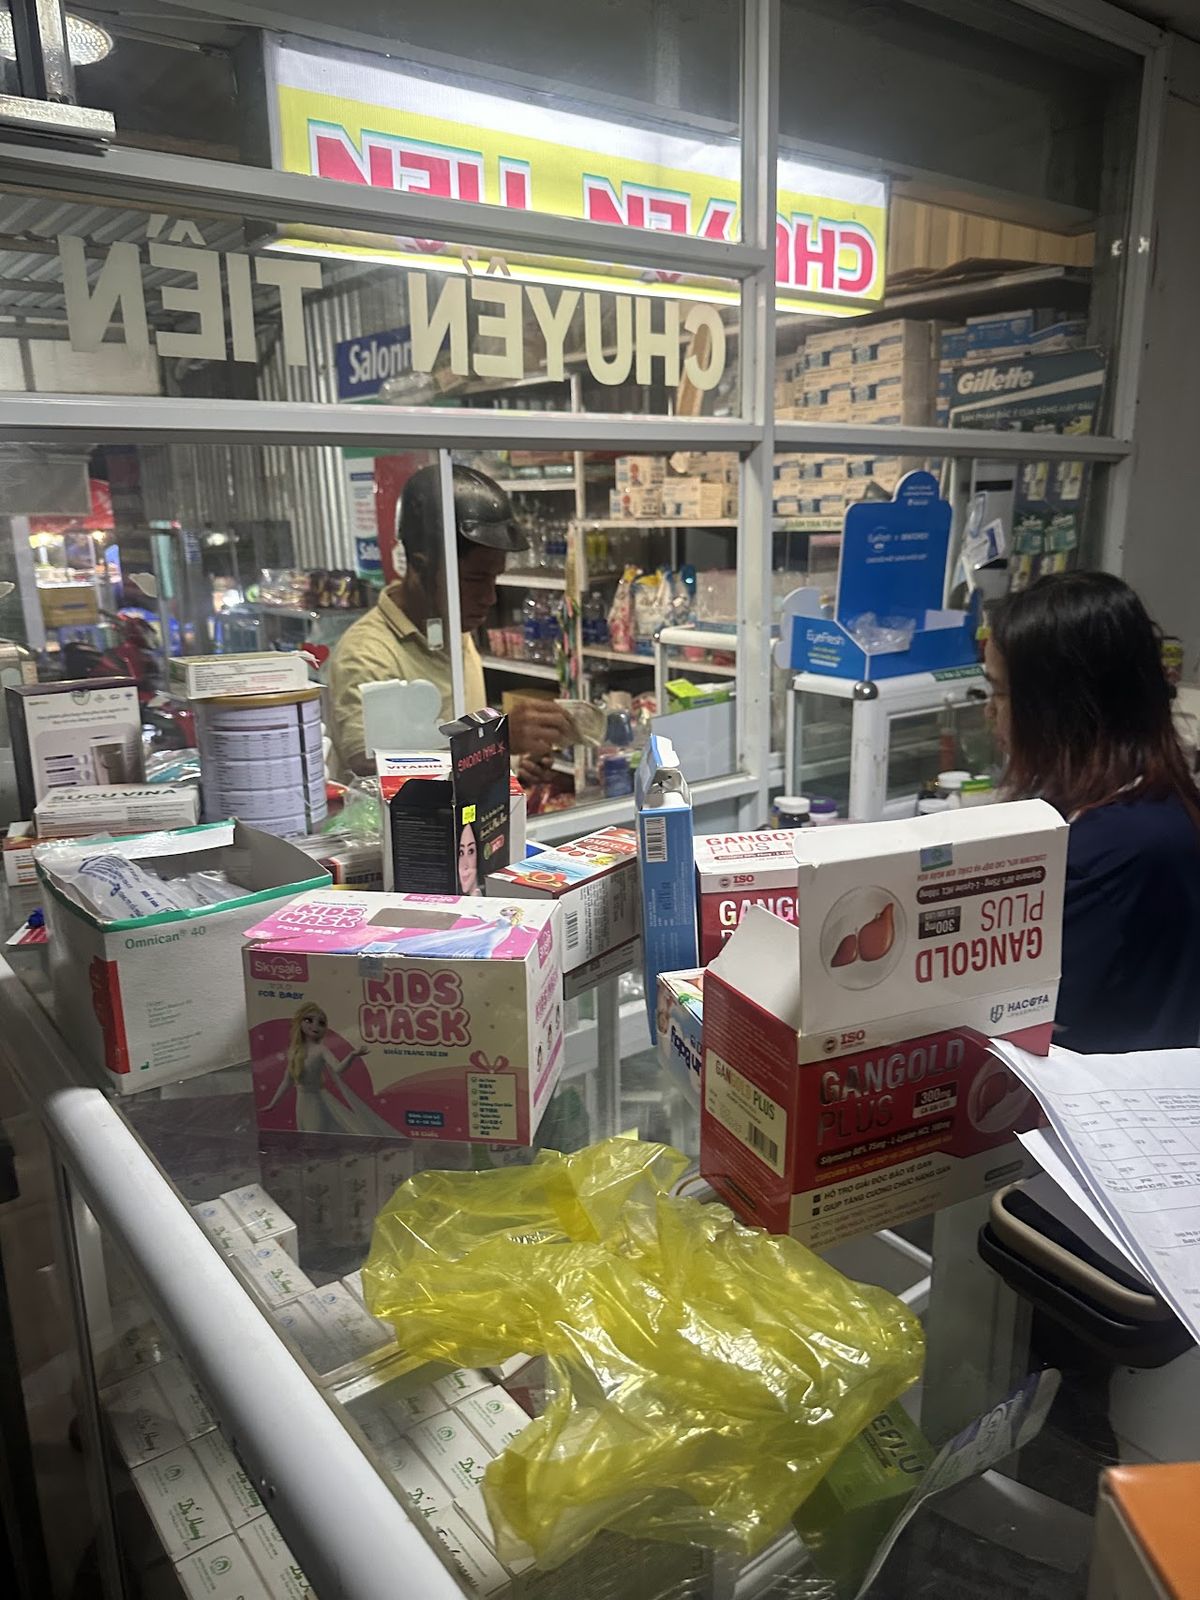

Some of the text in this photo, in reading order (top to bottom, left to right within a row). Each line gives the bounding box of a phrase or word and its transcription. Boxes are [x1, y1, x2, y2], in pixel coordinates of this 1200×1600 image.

[957, 366, 1034, 395] Gillette
[710, 842, 770, 855] PLUS
[733, 874, 755, 884] ISO
[279, 912, 363, 928] MASK
[297, 904, 366, 917] KIDS
[719, 896, 799, 927] GANG
[191, 925, 206, 937] 40
[915, 890, 1045, 983] GANGOLD PLUS
[258, 990, 275, 998] FOR
[364, 968, 462, 1008] KIDS
[359, 1005, 470, 1046] MASK
[840, 1029, 865, 1045] ISO
[821, 1038, 965, 1106] GANGOLD
[753, 1090, 775, 1121] PLUS
[816, 1094, 894, 1147] PLUS
